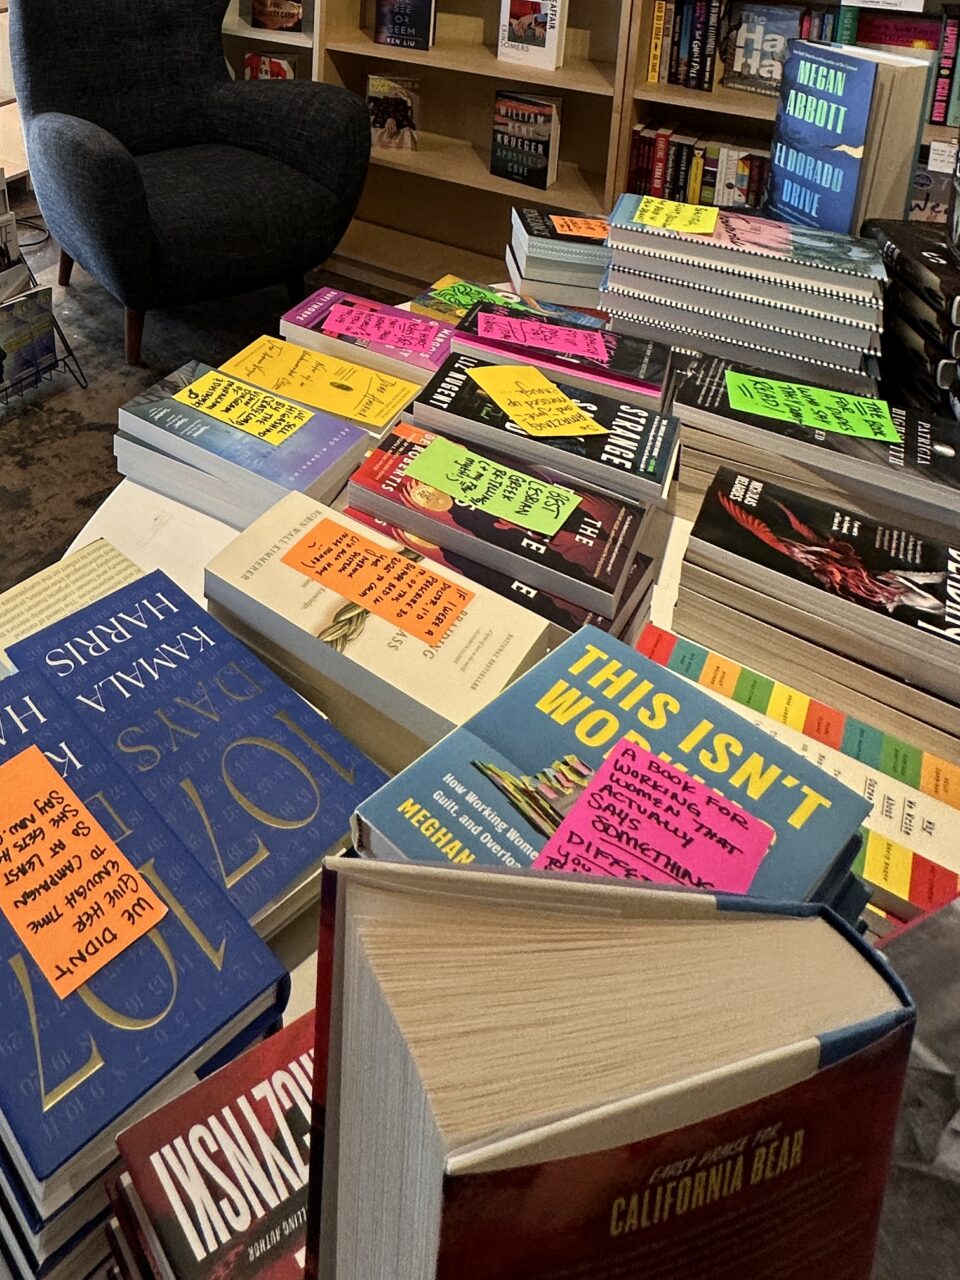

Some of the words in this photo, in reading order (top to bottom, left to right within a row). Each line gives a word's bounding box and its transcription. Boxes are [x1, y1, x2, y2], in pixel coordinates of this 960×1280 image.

[548, 3, 558, 31] AFFAIR
[796, 60, 847, 97] MEGAN
[499, 105, 545, 125] WILLIAM
[786, 89, 848, 135] ABBOTT
[496, 133, 545, 155] KRUEGER
[782, 179, 822, 218] DRIVE
[454, 356, 478, 370] LIZ
[429, 371, 468, 409] NUGENT
[601, 404, 649, 470] STRANGE
[916, 420, 932, 465] PATRICIA
[502, 475, 527, 502] GREEK
[515, 480, 548, 516] LESBIAN
[542, 490, 570, 519] BEST
[575, 517, 603, 547] THE
[45, 591, 181, 678] HARRIS
[75, 623, 216, 714] KAMALA
[117, 660, 264, 773] DAYS
[567, 644, 681, 730] THIS
[677, 718, 832, 830] ISN'T
[33, 789, 64, 816] SAY
[181, 708, 356, 890] 107
[442, 772, 468, 794] How
[464, 791, 509, 833] Working
[613, 758, 702, 818] WORKING
[621, 748, 637, 762] A
[647, 760, 696, 795] BOOK
[705, 795, 750, 831] FOR
[49, 803, 79, 829] SHE
[396, 797, 477, 865] MEGHAN
[432, 789, 459, 817] Guilt,
[458, 813, 483, 835] and
[587, 792, 641, 831] SAYS
[598, 784, 695, 849] ACTUALLY
[609, 772, 681, 818] WOMEN
[691, 818, 744, 855] THAT
[12, 827, 46, 853] GETS
[4, 853, 45, 887] LEAST
[13, 854, 83, 910] CAMPAIGN
[65, 860, 120, 909] ENOUGH
[104, 873, 139, 908] GIVE
[26, 904, 64, 934] TIME
[72, 901, 105, 934] HER
[121, 896, 154, 926] WE
[609, 1155, 744, 1237] CALIFORNIA
[750, 1129, 805, 1184] BEAR
[247, 1227, 282, 1262] AUTHOR
